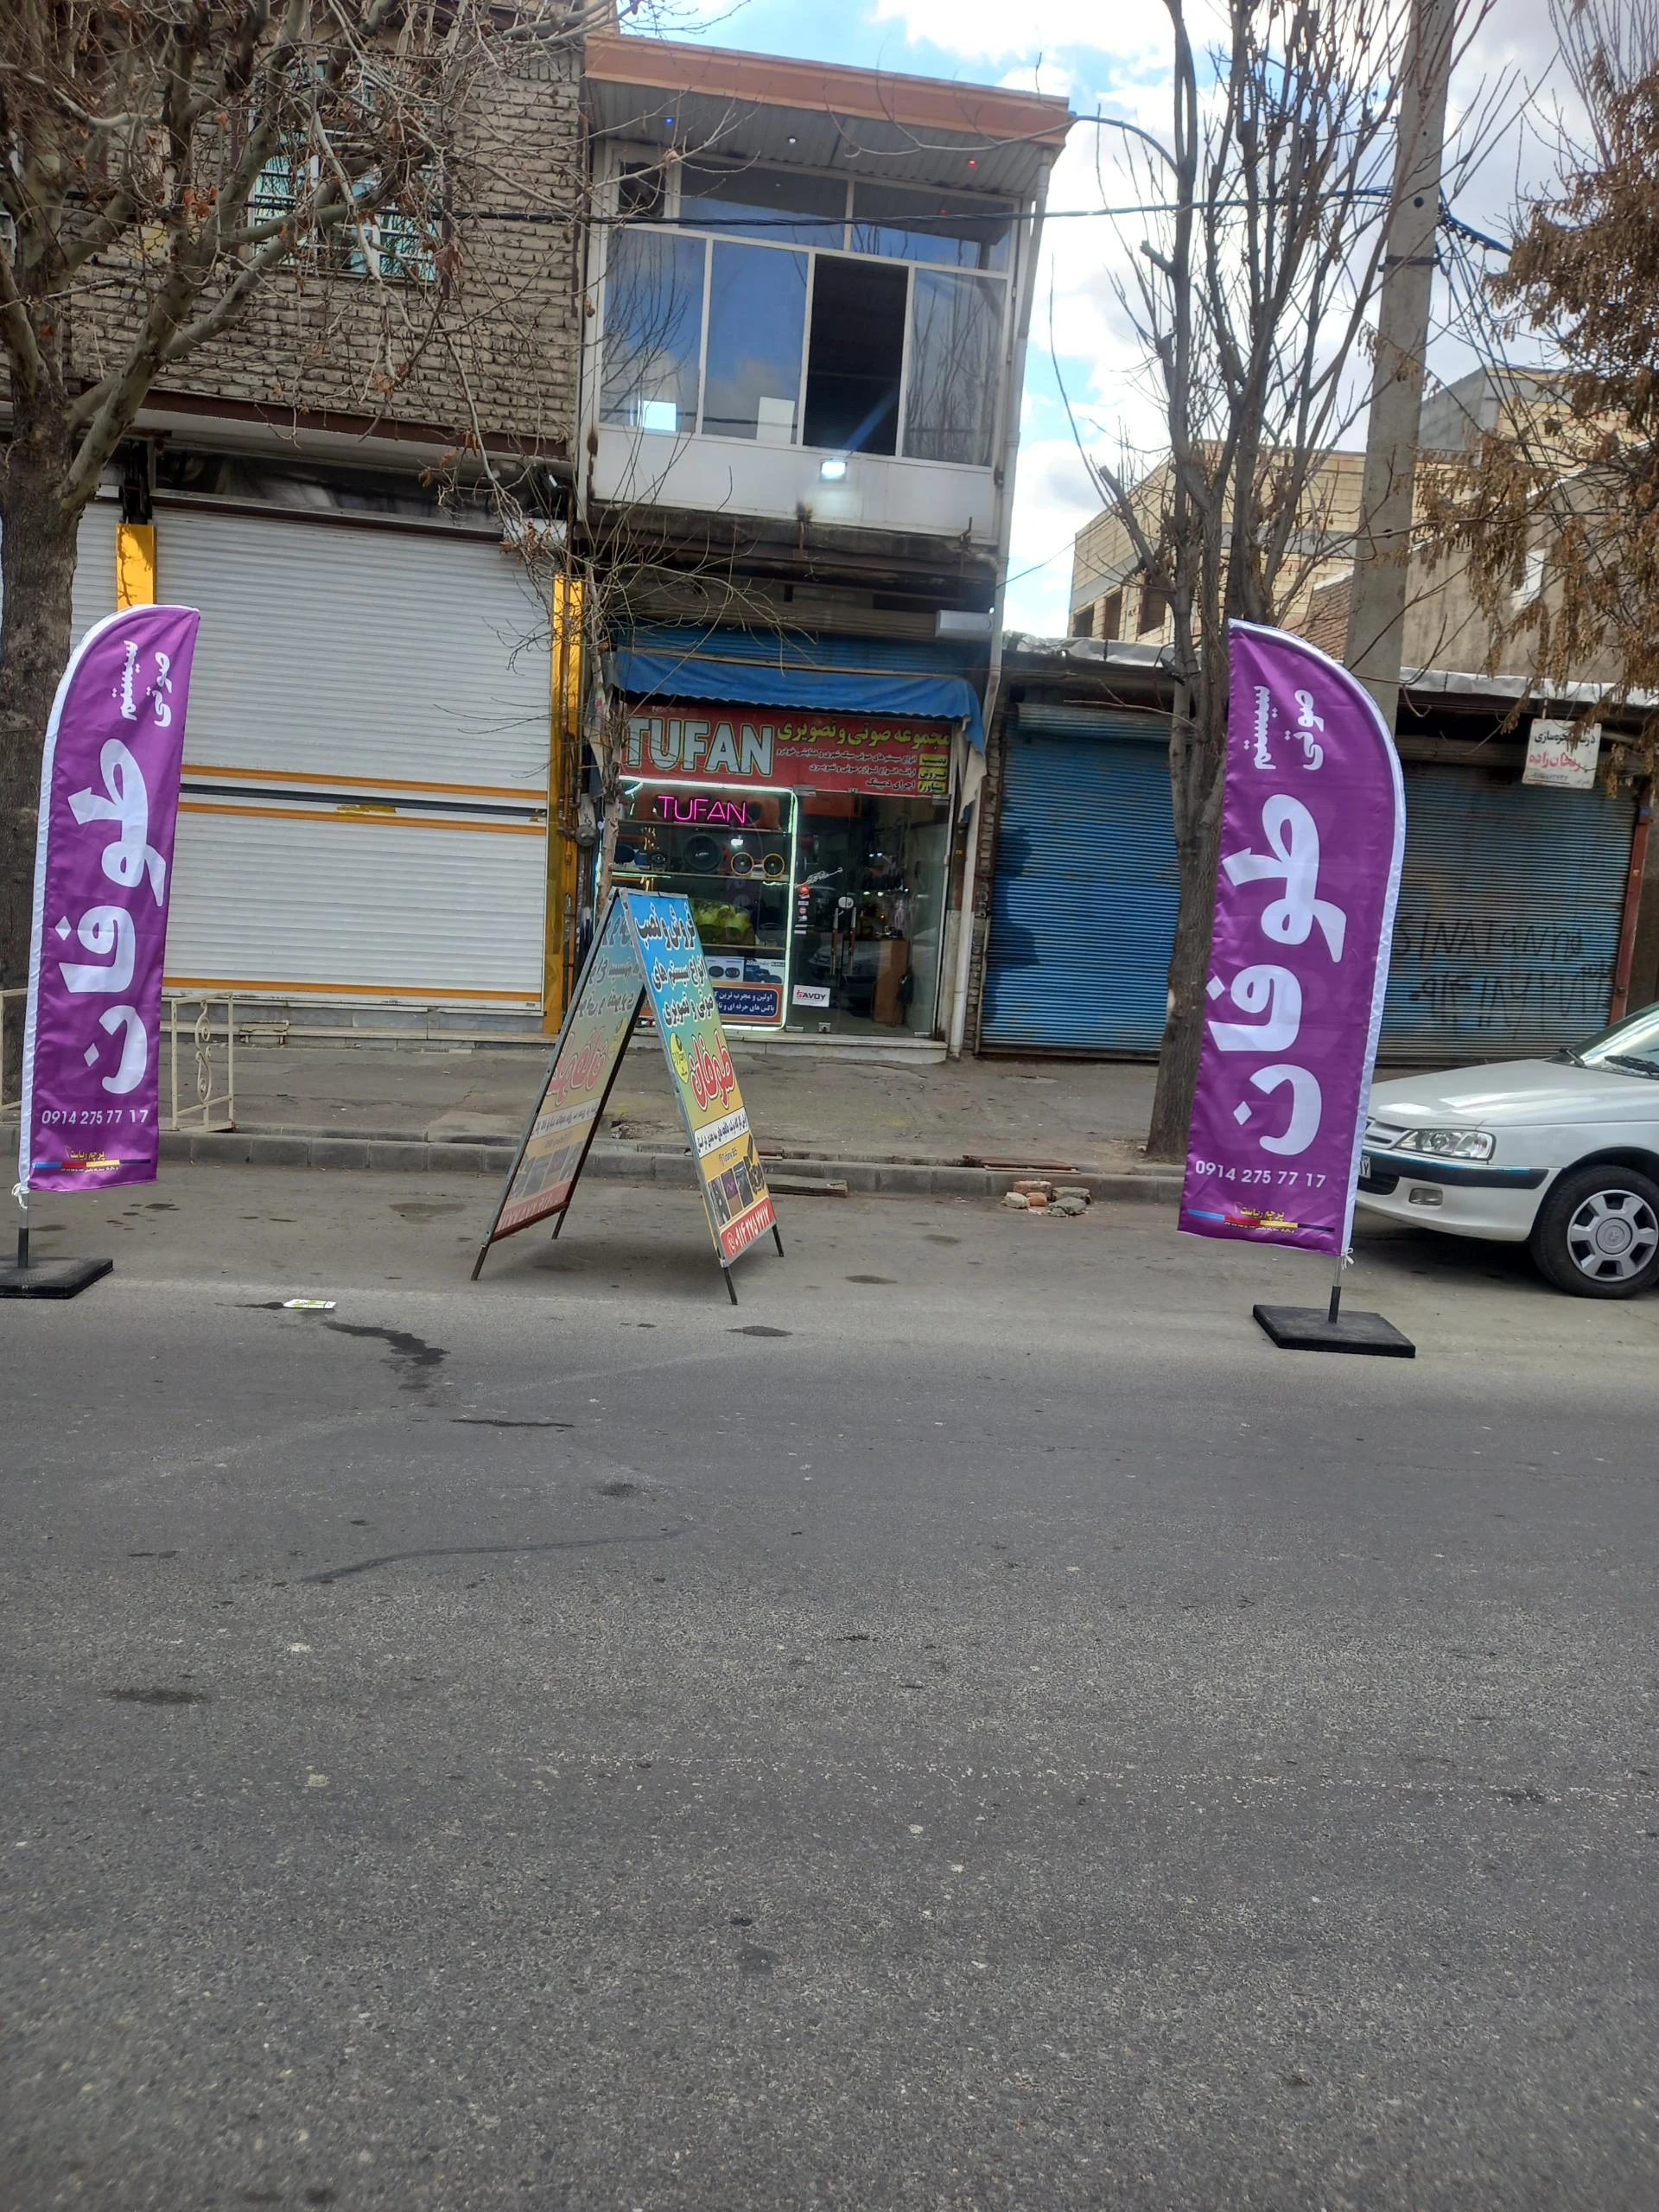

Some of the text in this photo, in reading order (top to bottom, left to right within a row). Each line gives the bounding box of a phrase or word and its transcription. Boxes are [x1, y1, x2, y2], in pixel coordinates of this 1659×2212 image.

[111, 640, 142, 721] سیستم
[146, 652, 173, 728] صوتی
[626, 716, 774, 778] TUFAN
[778, 720, 951, 750] مجموعه صوتی و تصویری
[1243, 685, 1279, 771] سیستم
[1284, 689, 1325, 771] صوتی
[657, 794, 747, 824] TUFAN
[56, 738, 166, 1095] طوفان
[635, 902, 662, 950] نصب
[669, 901, 696, 950] فروش
[668, 960, 690, 989] سیستم
[689, 954, 708, 987] انواع
[1205, 793, 1346, 1156] طوفان
[663, 992, 690, 1027] تصویری
[698, 989, 714, 1020] صوتی
[719, 991, 734, 1000] ترین
[757, 994, 772, 1002] اولین
[689, 1029, 734, 1111] طوفان
[41, 1109, 149, 1125] 0914 275 77 17
[1195, 1160, 1326, 1188] 0914 275 77 17
